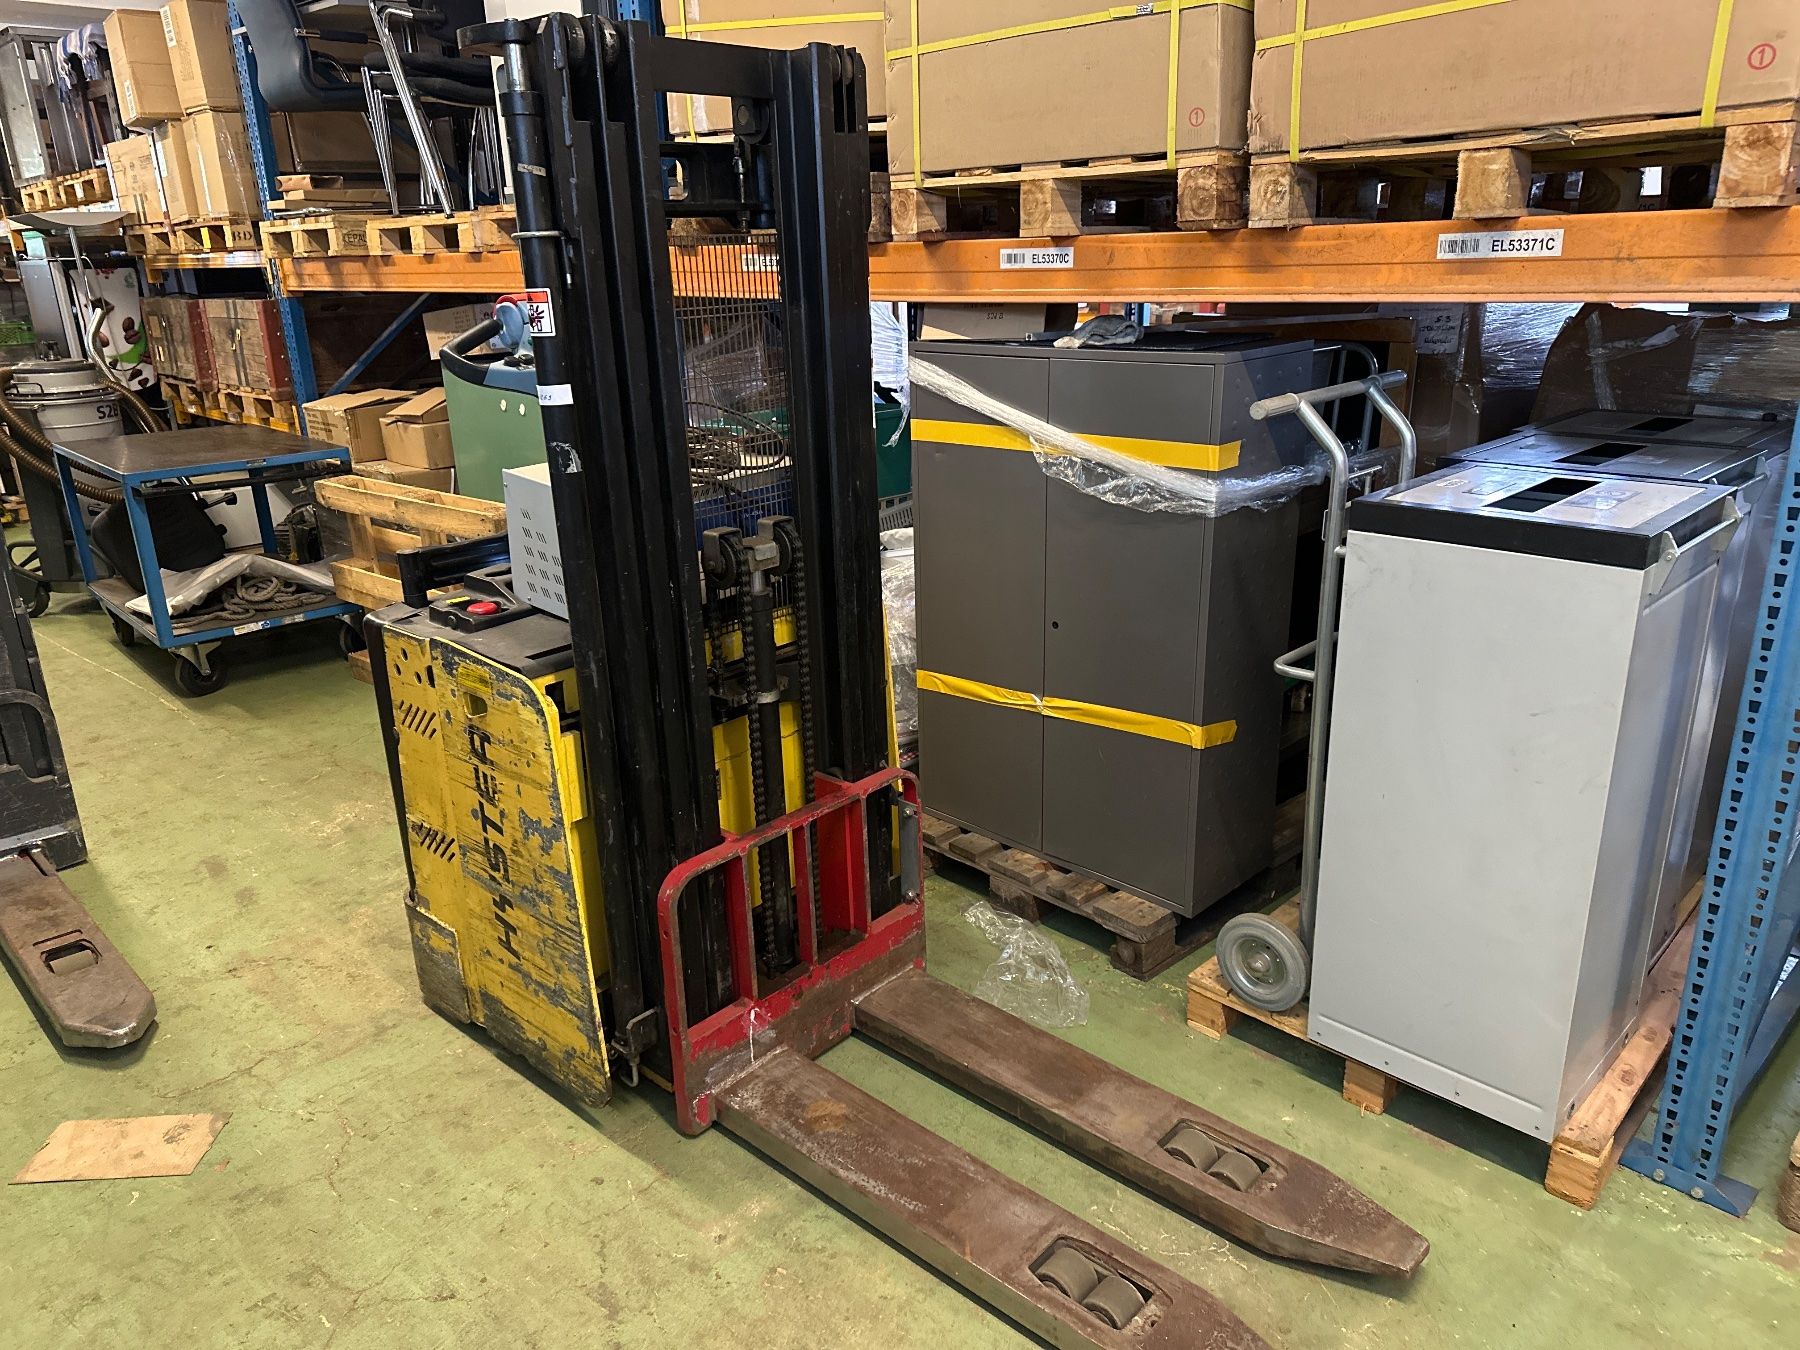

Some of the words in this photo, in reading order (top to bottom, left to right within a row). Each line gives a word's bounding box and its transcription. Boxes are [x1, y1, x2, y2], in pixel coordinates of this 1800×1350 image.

[1491, 238, 1556, 253] EL53371C
[1032, 253, 1070, 264] EL53370C
[465, 724, 522, 961] HYSTER
